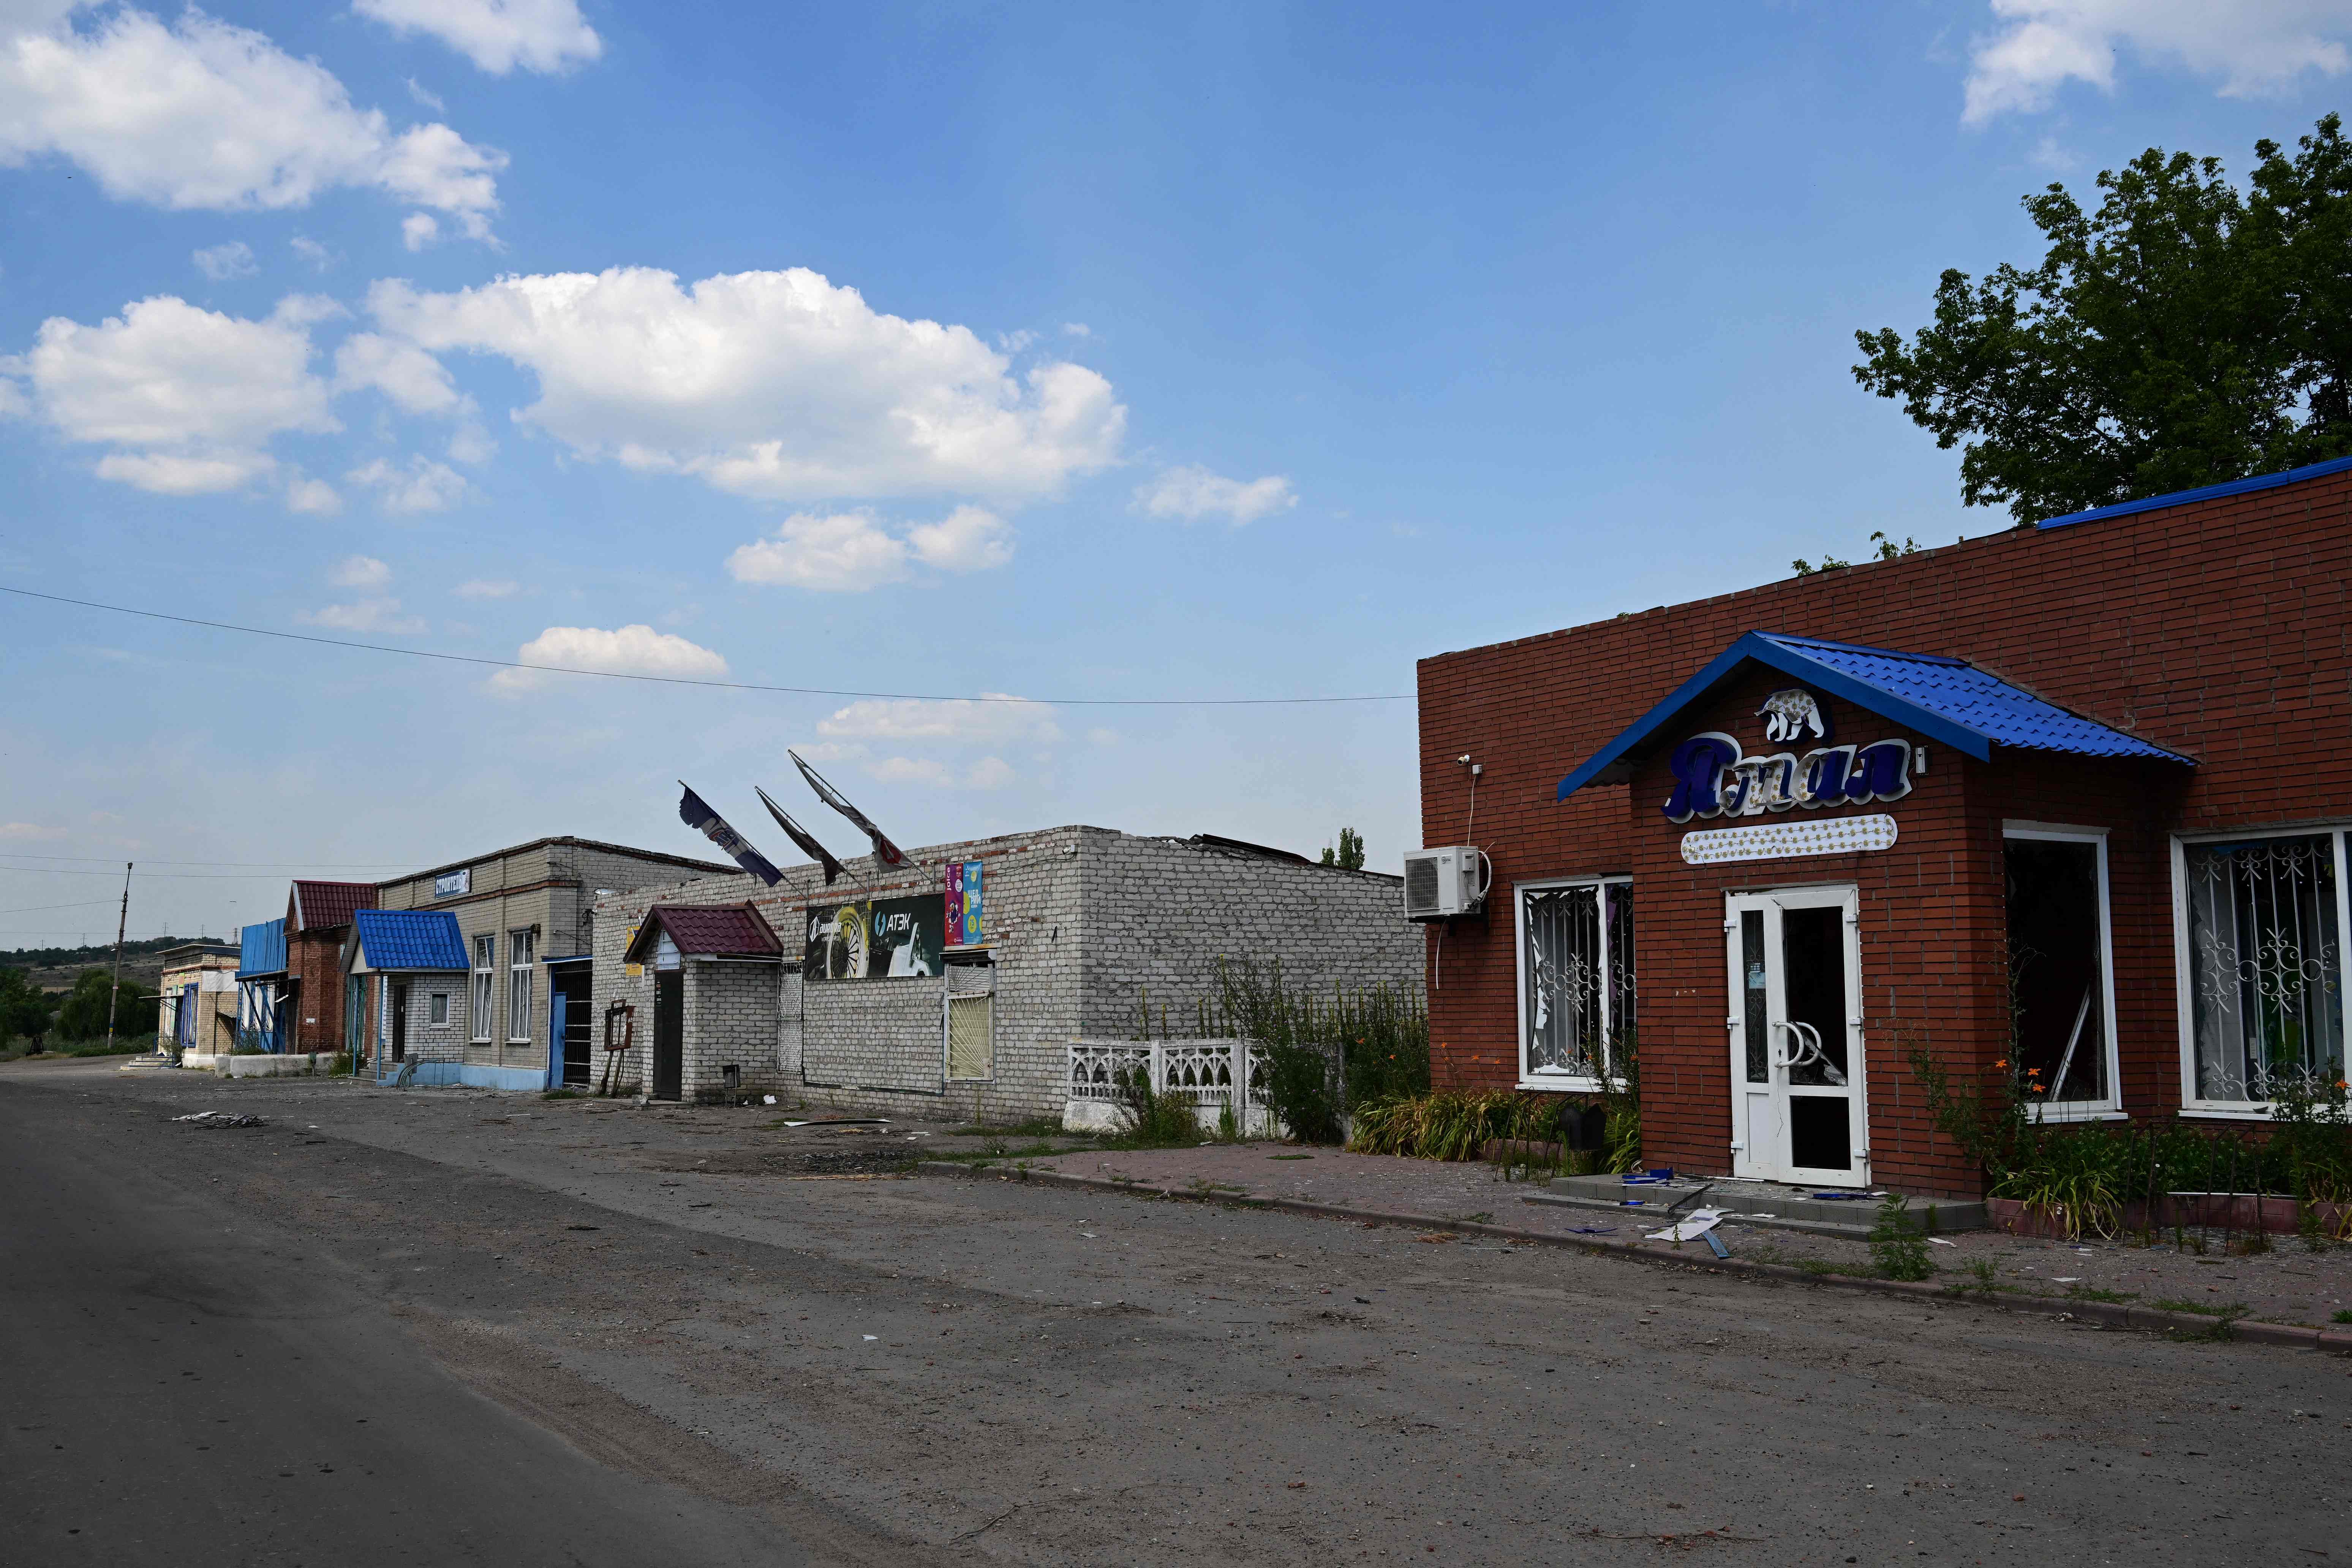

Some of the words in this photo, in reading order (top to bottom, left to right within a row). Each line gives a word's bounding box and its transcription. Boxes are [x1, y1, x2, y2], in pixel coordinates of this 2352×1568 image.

[1661, 733, 1911, 823] Ямал
[436, 874, 462, 894] СТРОИТЕЛЬ
[968, 889, 980, 898] ЩЕД
[887, 913, 911, 931] АТЭК
